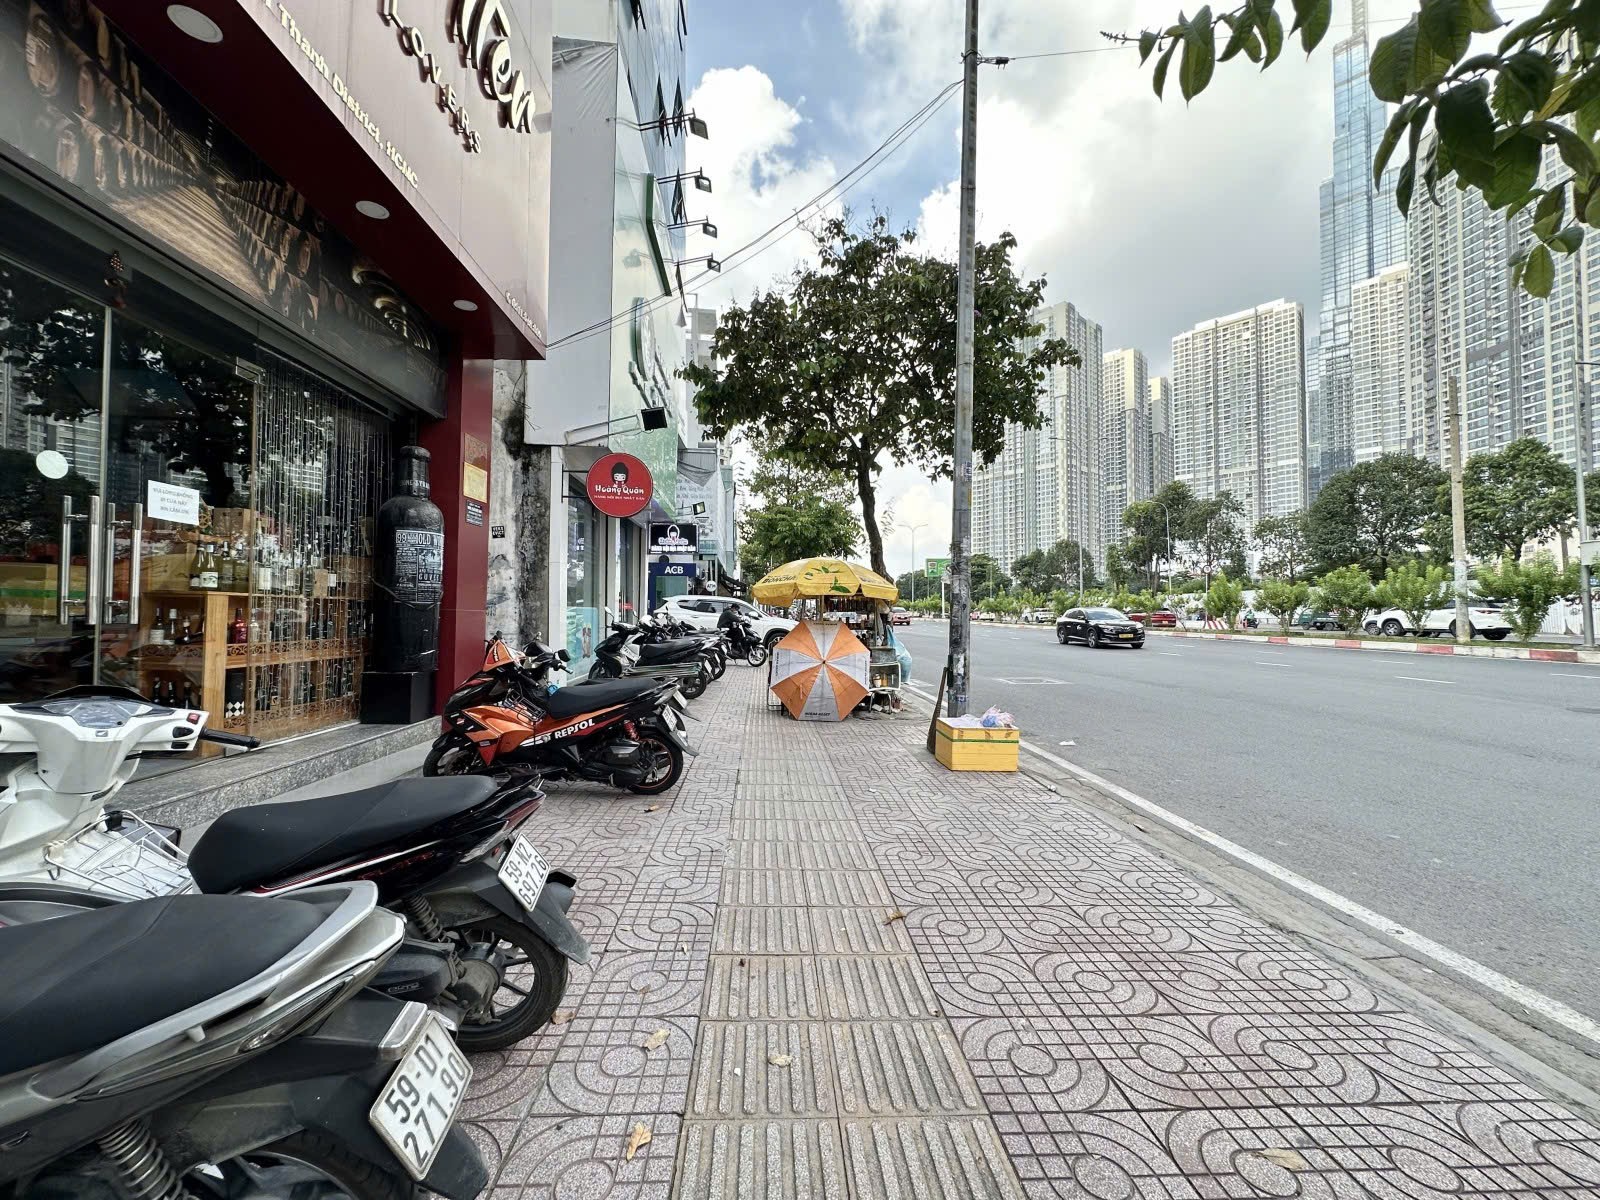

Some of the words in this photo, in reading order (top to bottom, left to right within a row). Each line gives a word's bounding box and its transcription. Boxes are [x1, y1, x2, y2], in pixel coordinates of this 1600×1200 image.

[277, 3, 330, 79] Thanh
[664, 566, 684, 575] ACB
[554, 718, 596, 739] REPSOL
[518, 855, 547, 905] 697.26
[384, 1033, 443, 1124] 59-D1
[403, 1052, 466, 1168] 271.90
